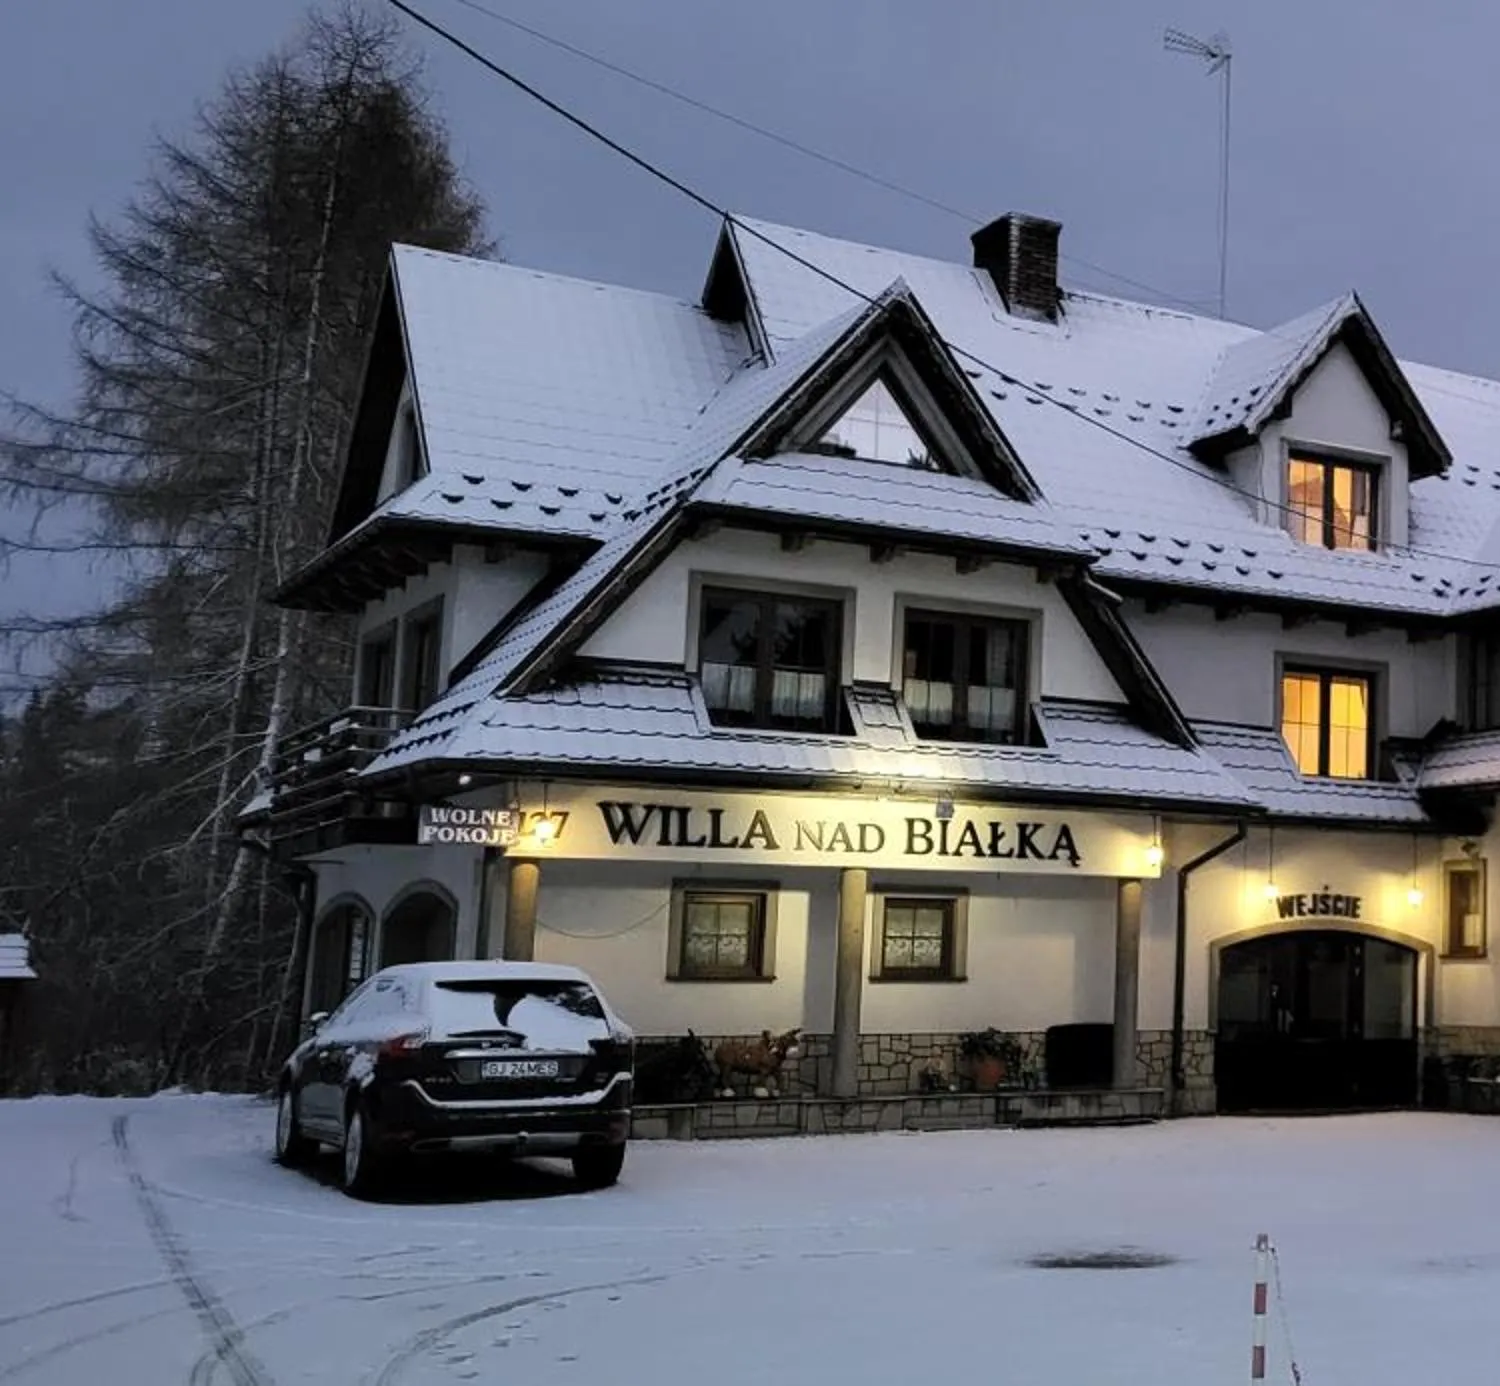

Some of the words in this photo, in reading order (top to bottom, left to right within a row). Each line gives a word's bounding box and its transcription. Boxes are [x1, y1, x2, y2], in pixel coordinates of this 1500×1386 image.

[430, 807, 512, 826] WOLNE
[423, 825, 516, 845] POKOJE
[597, 801, 780, 850] WILLA
[794, 819, 886, 853] NAD
[904, 817, 1082, 867] BIAŁKĄ
[1276, 884, 1362, 918] WEJŚCIE
